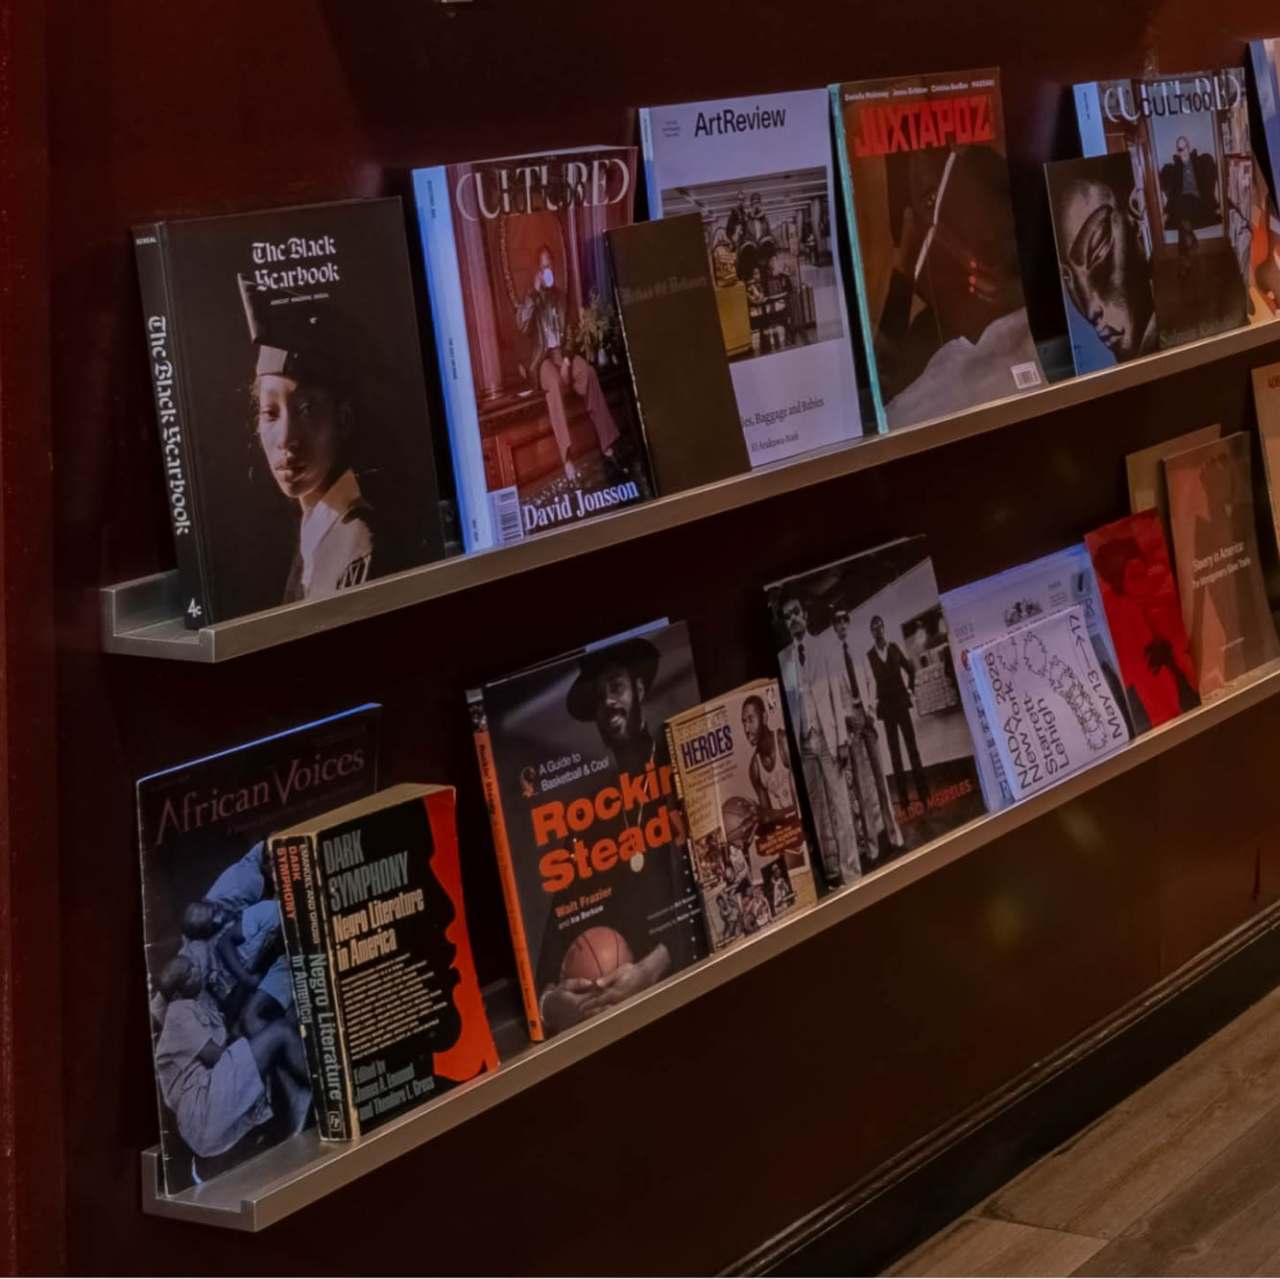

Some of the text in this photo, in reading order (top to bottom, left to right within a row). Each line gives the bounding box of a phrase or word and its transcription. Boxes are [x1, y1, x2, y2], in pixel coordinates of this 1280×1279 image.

[694, 105, 787, 138] ArtReview
[855, 94, 993, 157] JUXTAPOZ
[252, 235, 337, 264] The Black
[254, 262, 340, 291] Yearbook
[148, 315, 189, 535] The Black Yearbook
[523, 480, 640, 530] David Jonsson
[1068, 614, 1123, 740] May 13 17
[680, 725, 734, 769] HEROES
[1003, 717, 1033, 790] NADA
[1004, 682, 1044, 784] New York
[1036, 698, 1070, 770] Lehigh
[539, 751, 582, 776] A Guide to
[541, 767, 583, 793] Basketball
[155, 781, 270, 846] African
[274, 748, 365, 806] Voices
[288, 846, 301, 881] DARK
[322, 829, 365, 874] DARK
[539, 805, 686, 893] Steady
[277, 847, 297, 920] SYMPHONY
[328, 851, 408, 911] SYMPHONY
[579, 887, 614, 908] Frazier
[333, 888, 425, 943] Negro Literature
[335, 928, 397, 972] in America
[294, 970, 313, 1024] America
[308, 953, 342, 1101] Negro Literature
